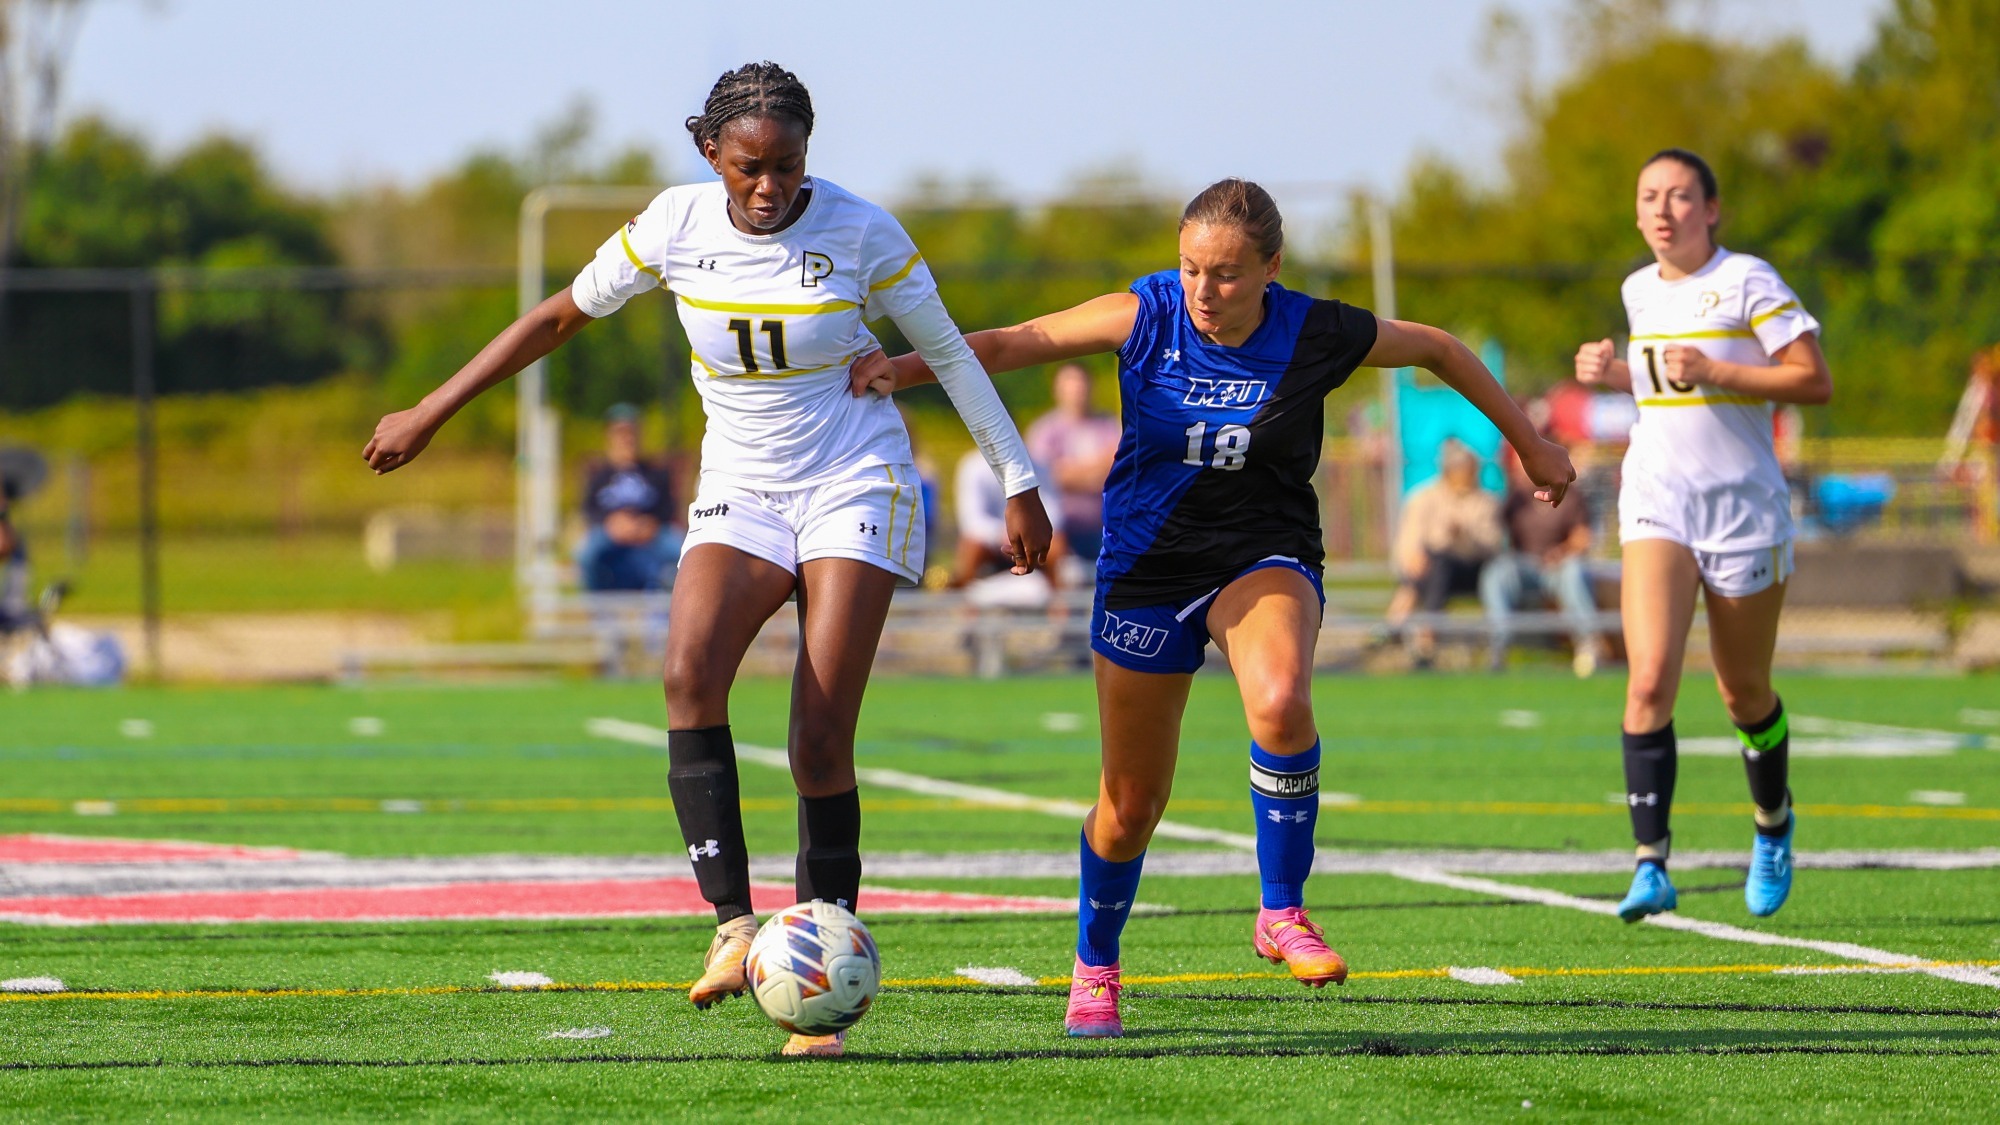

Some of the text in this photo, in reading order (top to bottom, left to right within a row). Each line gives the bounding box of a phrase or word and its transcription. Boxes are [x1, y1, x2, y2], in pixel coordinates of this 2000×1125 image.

[802, 250, 834, 288] P
[727, 318, 788, 373] 11
[1183, 376, 1268, 410] MU
[1183, 421, 1251, 471] 18
[1101, 610, 1169, 657] MU
